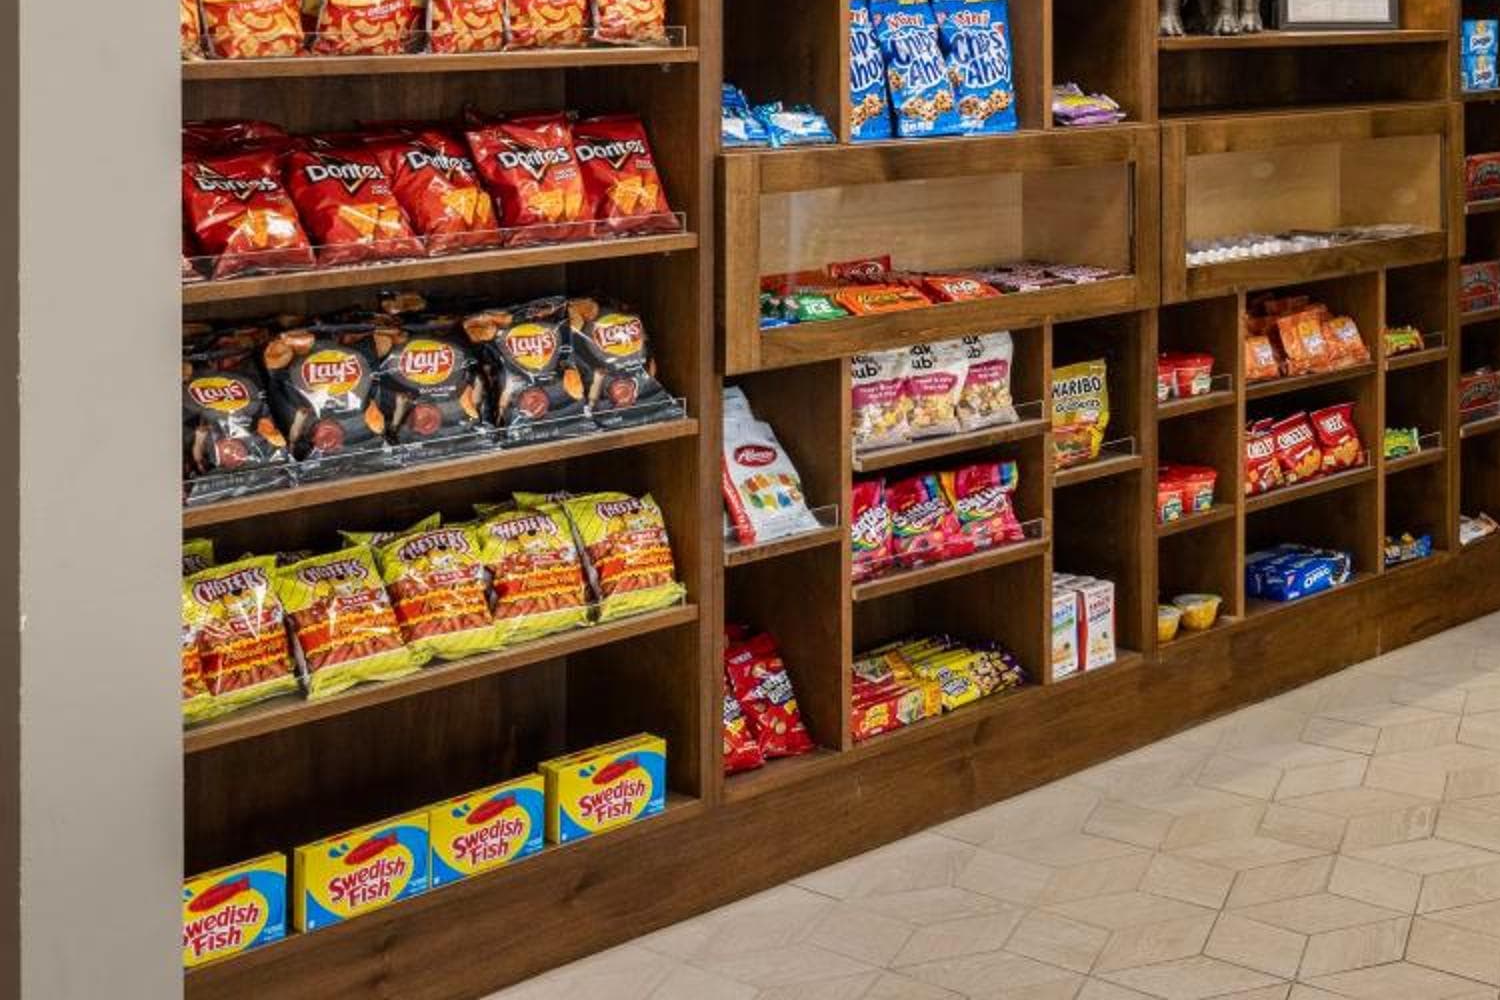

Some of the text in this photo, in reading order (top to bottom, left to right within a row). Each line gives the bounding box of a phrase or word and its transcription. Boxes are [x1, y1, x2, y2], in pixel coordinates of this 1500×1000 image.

[499, 145, 571, 169] Doritos
[575, 139, 646, 162] Doritos
[509, 331, 556, 356] Lay's
[307, 356, 357, 383] Lay's
[405, 346, 450, 375] Lay's
[197, 383, 244, 405] Lay's
[1052, 375, 1101, 398] HARIBO
[578, 779, 646, 817] Swedish
[595, 799, 633, 824] Fish
[452, 817, 524, 860] Swedish
[469, 839, 509, 866] Fish
[328, 856, 407, 902] Swedish
[348, 878, 392, 908] Fish
[191, 926, 242, 956] Fish
